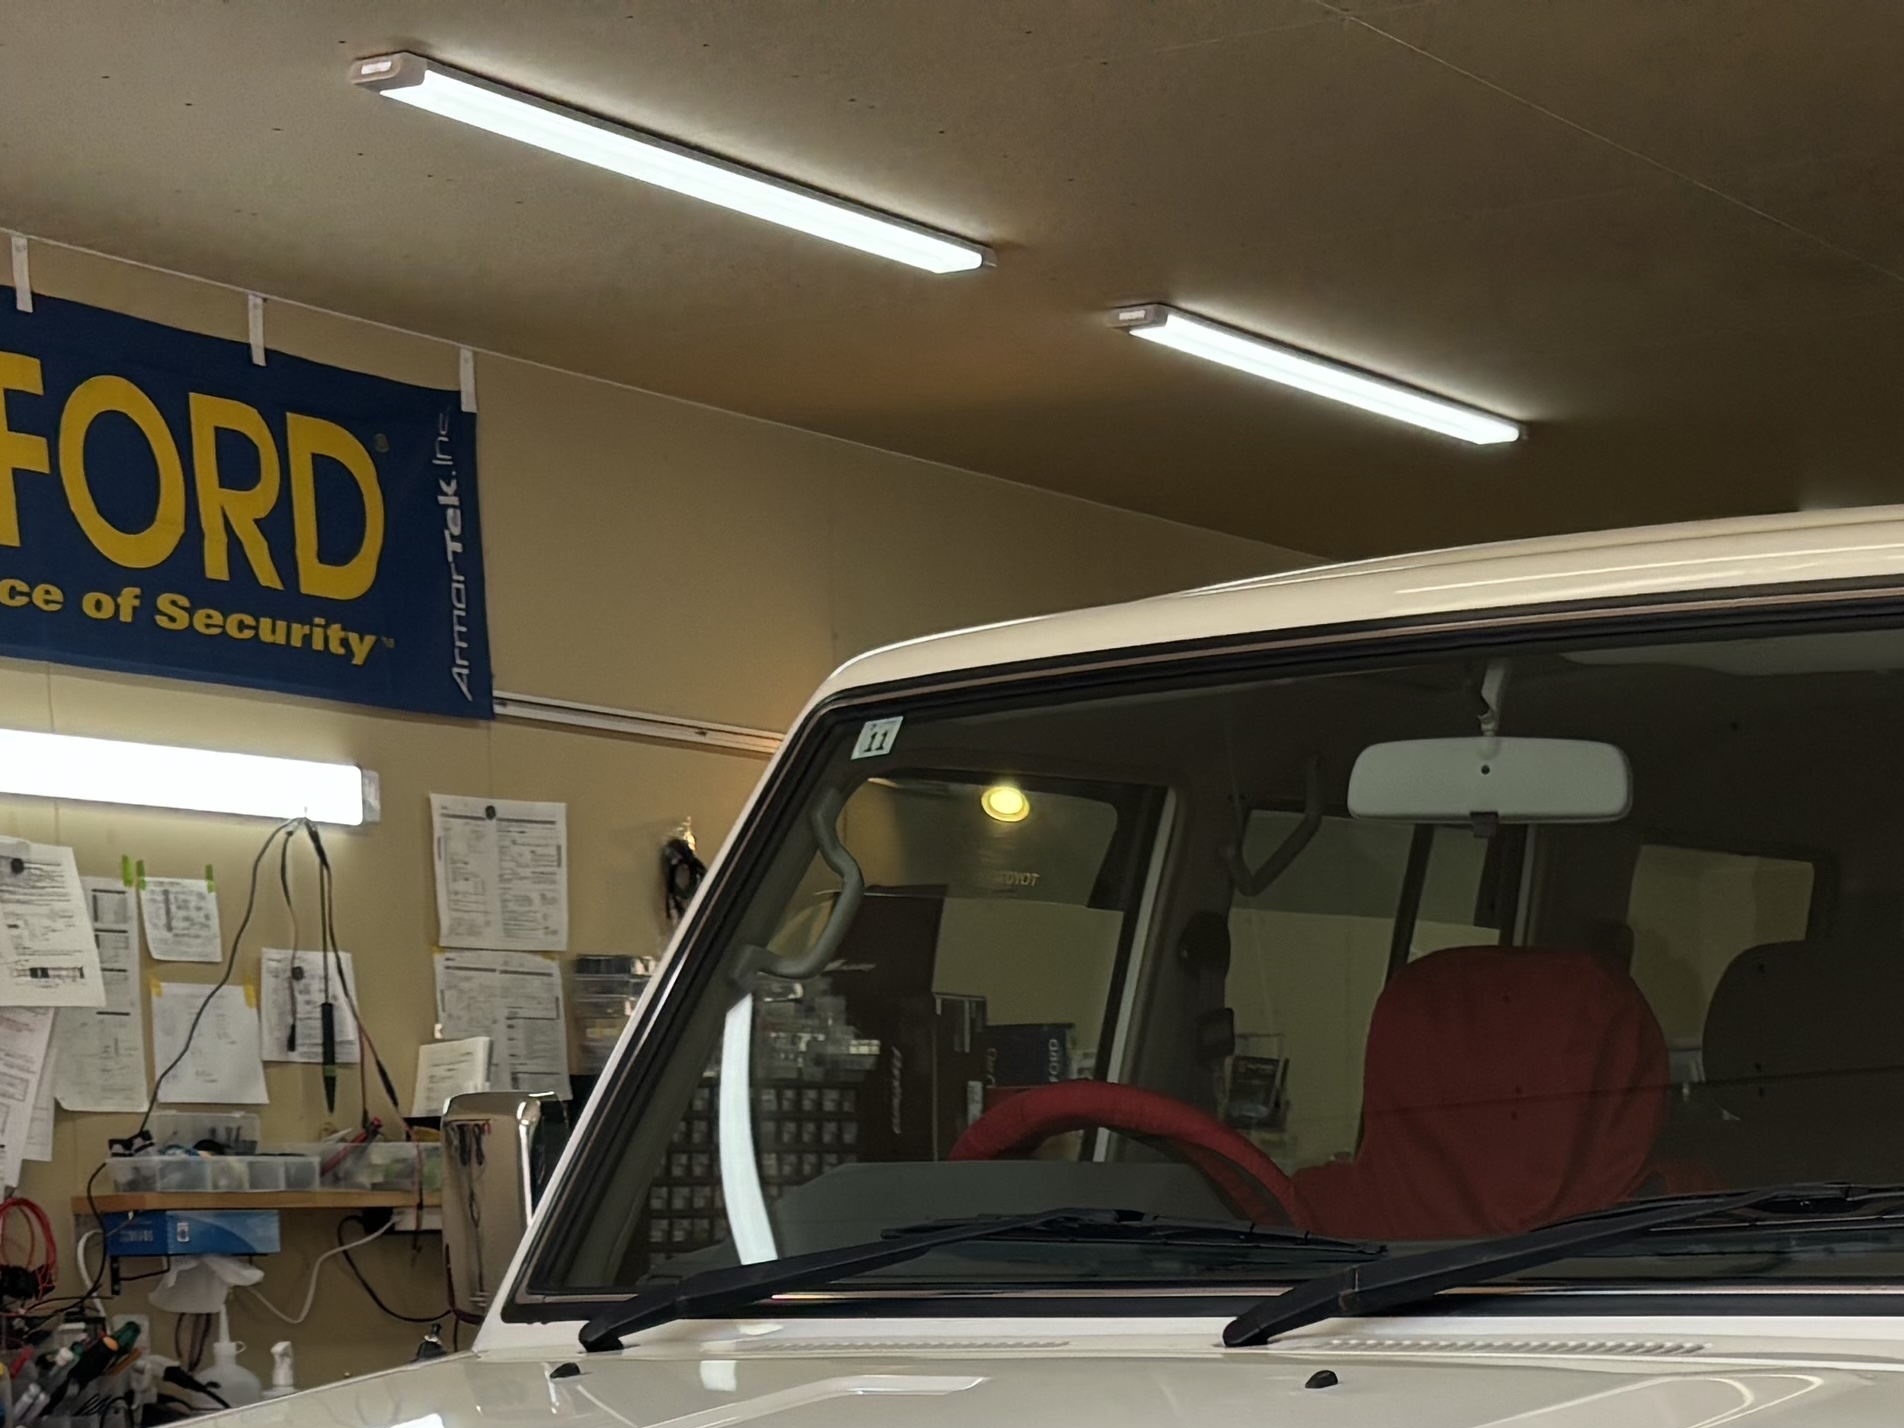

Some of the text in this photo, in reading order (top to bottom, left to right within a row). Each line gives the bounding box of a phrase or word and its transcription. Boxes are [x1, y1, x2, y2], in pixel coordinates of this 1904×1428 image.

[81, 586, 143, 624] of
[154, 592, 378, 667] Security
[863, 730, 889, 753] 11
